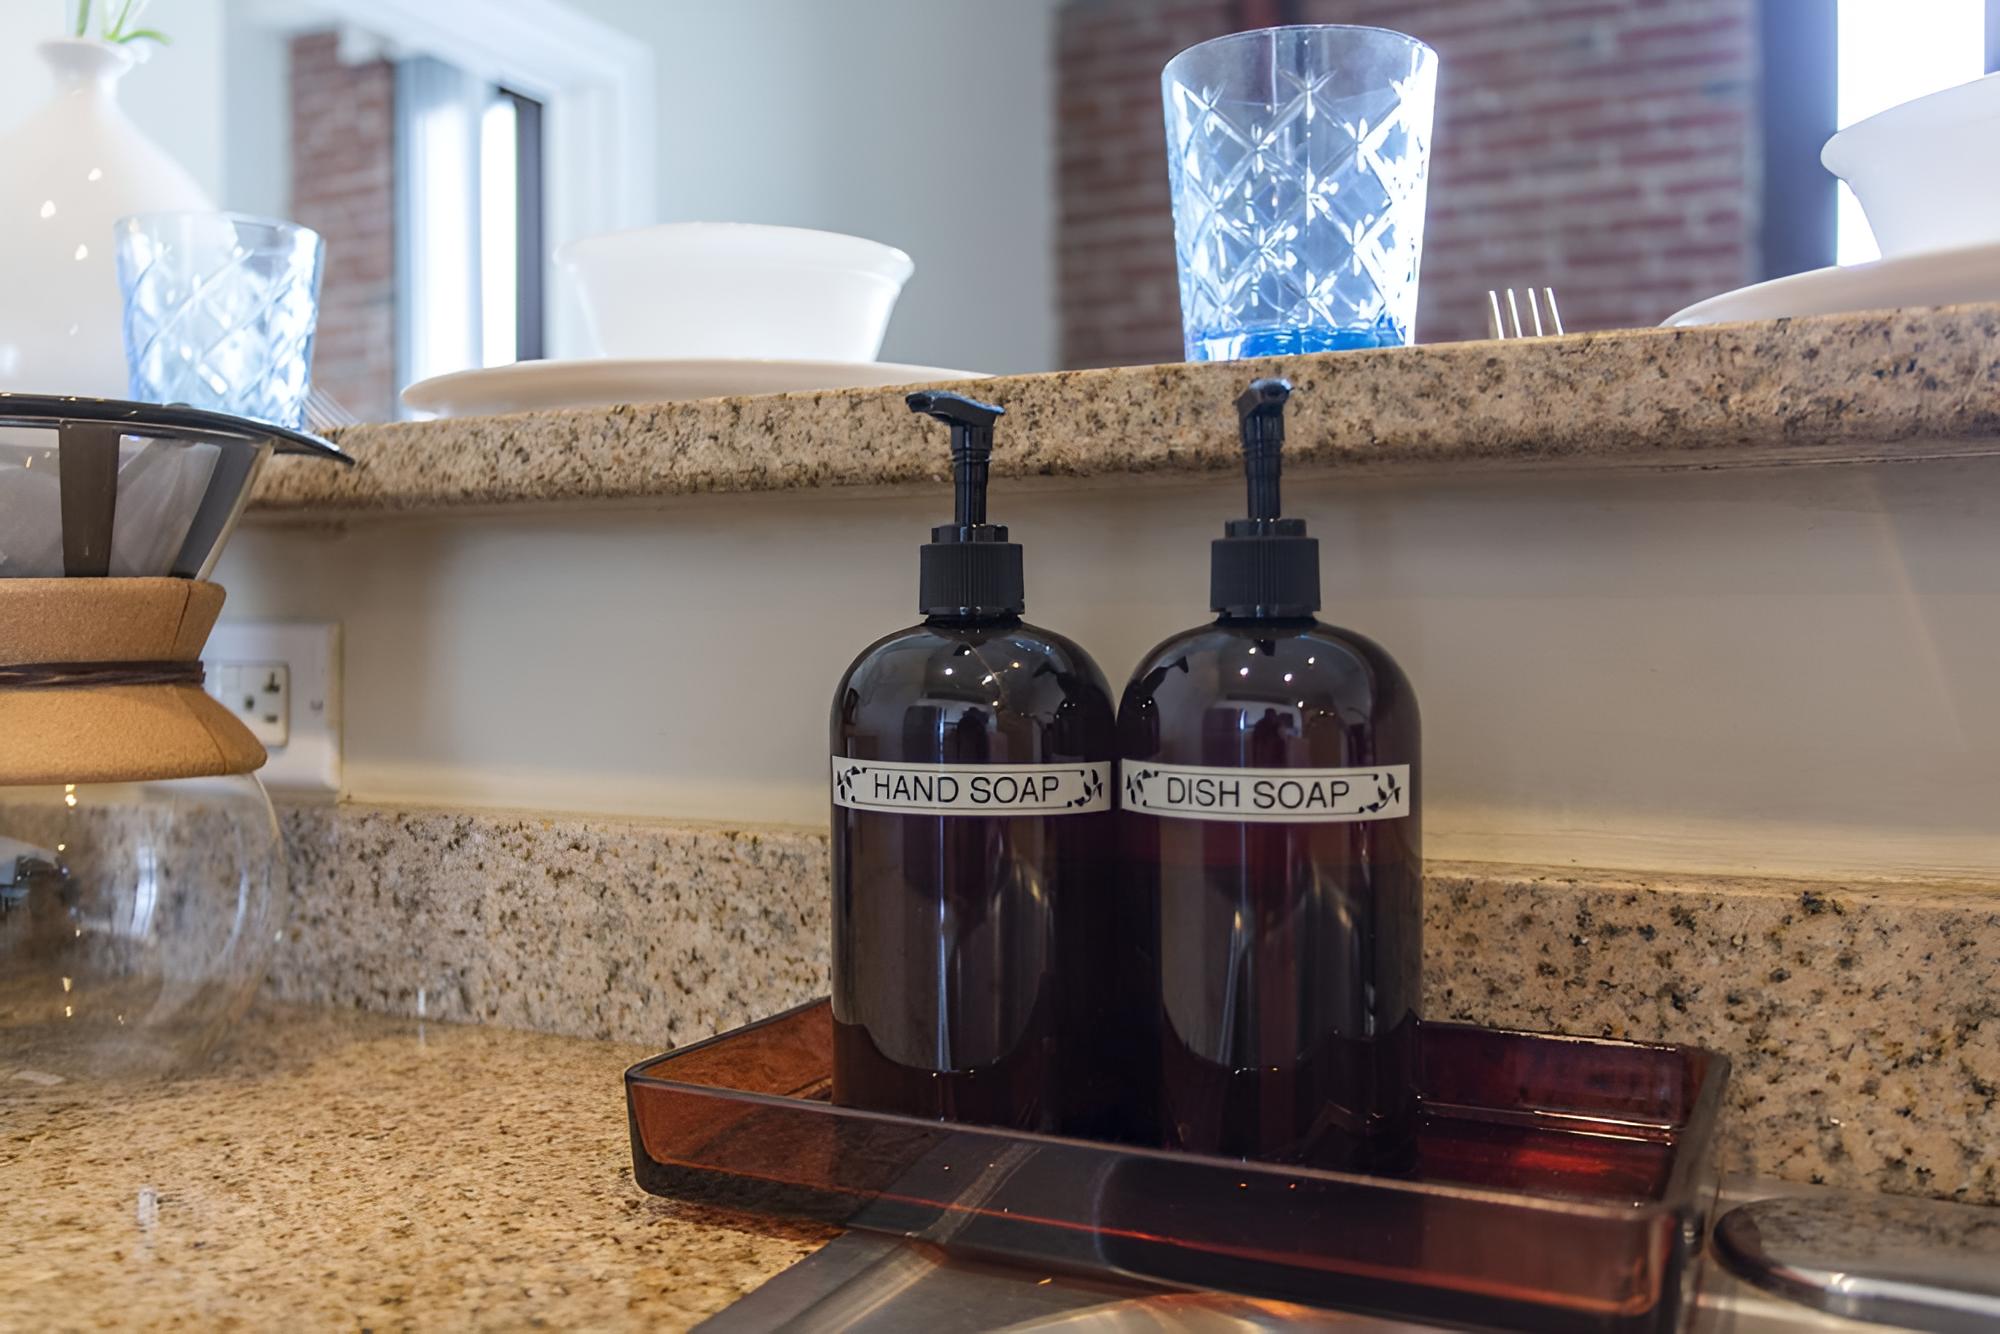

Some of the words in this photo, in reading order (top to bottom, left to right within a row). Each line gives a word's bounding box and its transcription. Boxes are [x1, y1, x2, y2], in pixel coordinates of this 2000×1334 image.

[874, 773, 960, 803] HAND
[969, 775, 1060, 804] SOAP
[1167, 777, 1241, 809] DISH
[1252, 780, 1351, 809] SOAP
